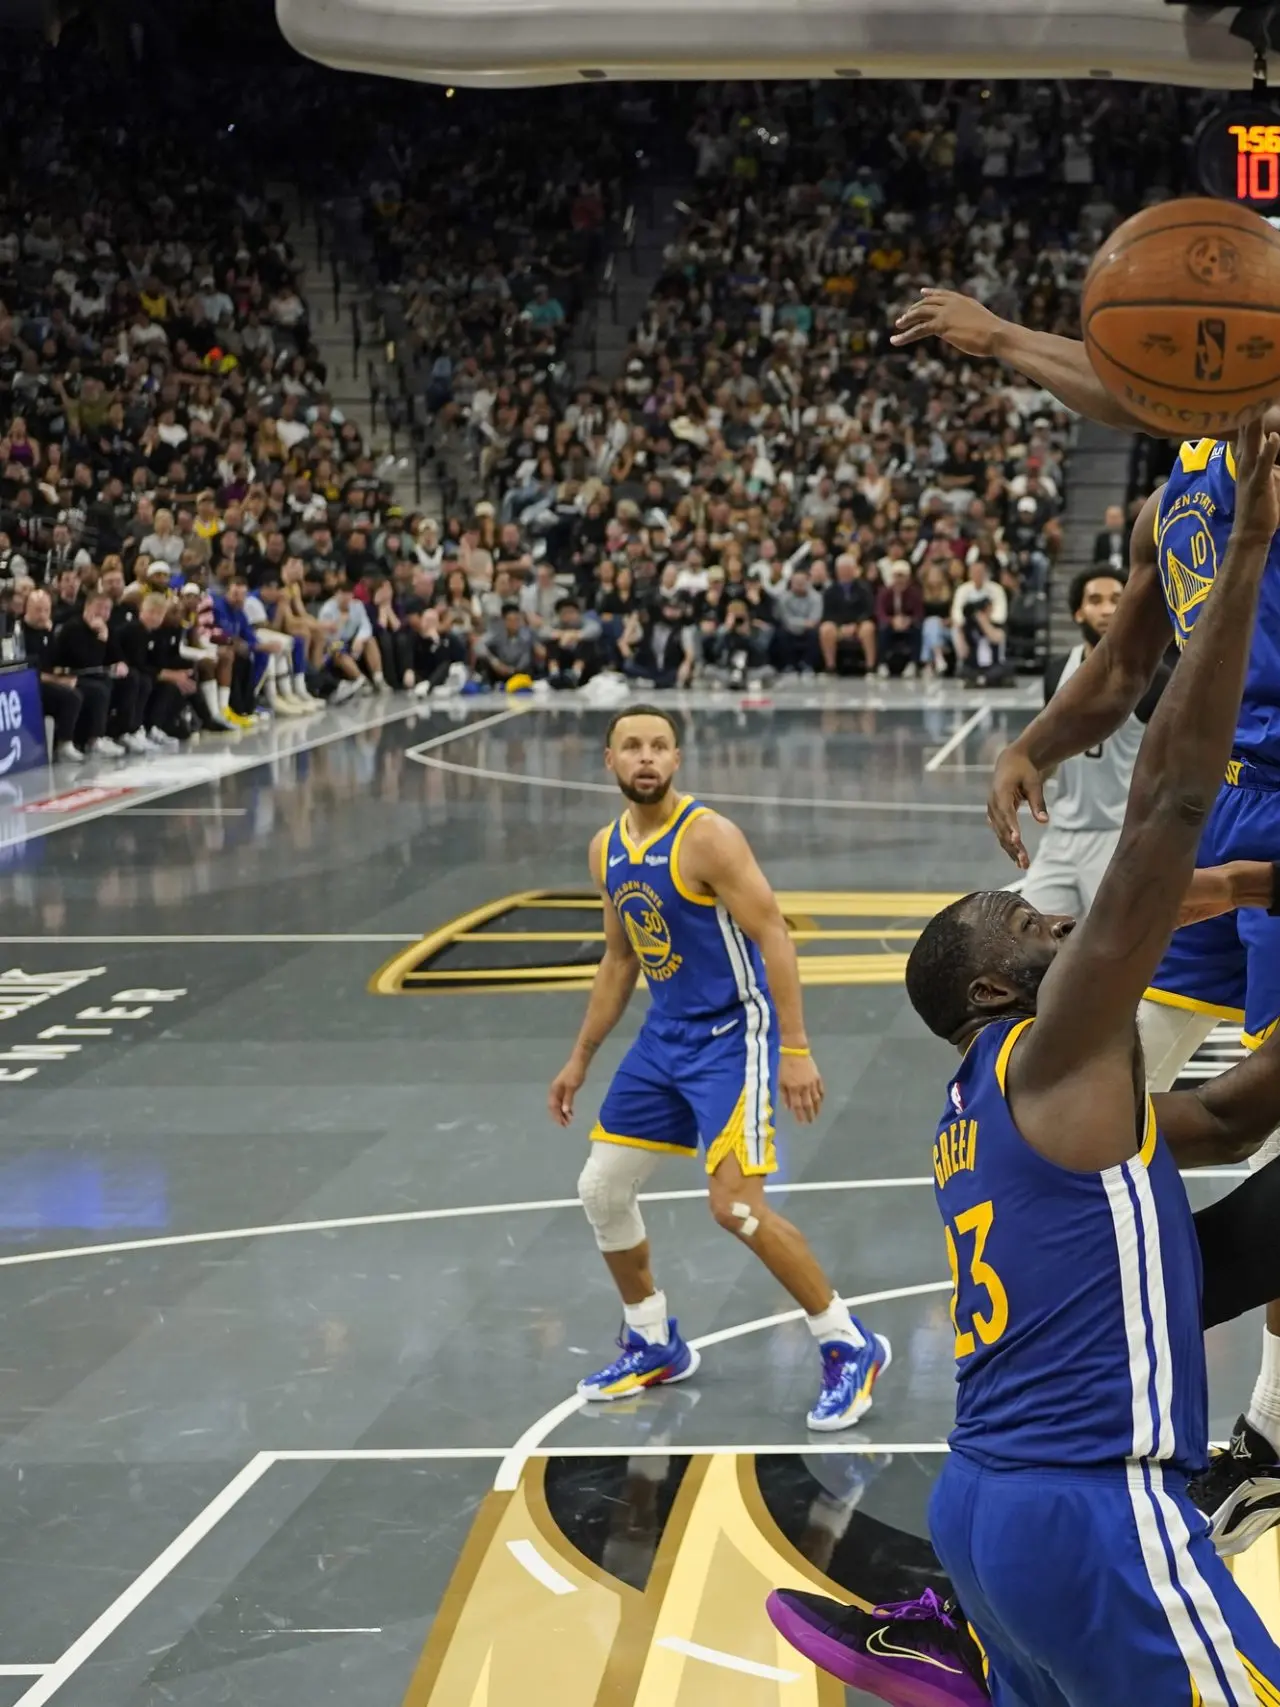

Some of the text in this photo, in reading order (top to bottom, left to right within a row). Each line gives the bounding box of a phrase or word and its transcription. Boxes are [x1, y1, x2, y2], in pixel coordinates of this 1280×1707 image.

[1237, 153, 1279, 199] 10
[1192, 491, 1217, 517] STATE
[1190, 531, 1207, 569] 10
[641, 910, 663, 934] 30
[932, 1119, 978, 1189] GREEN
[943, 1200, 1009, 1359] 23
